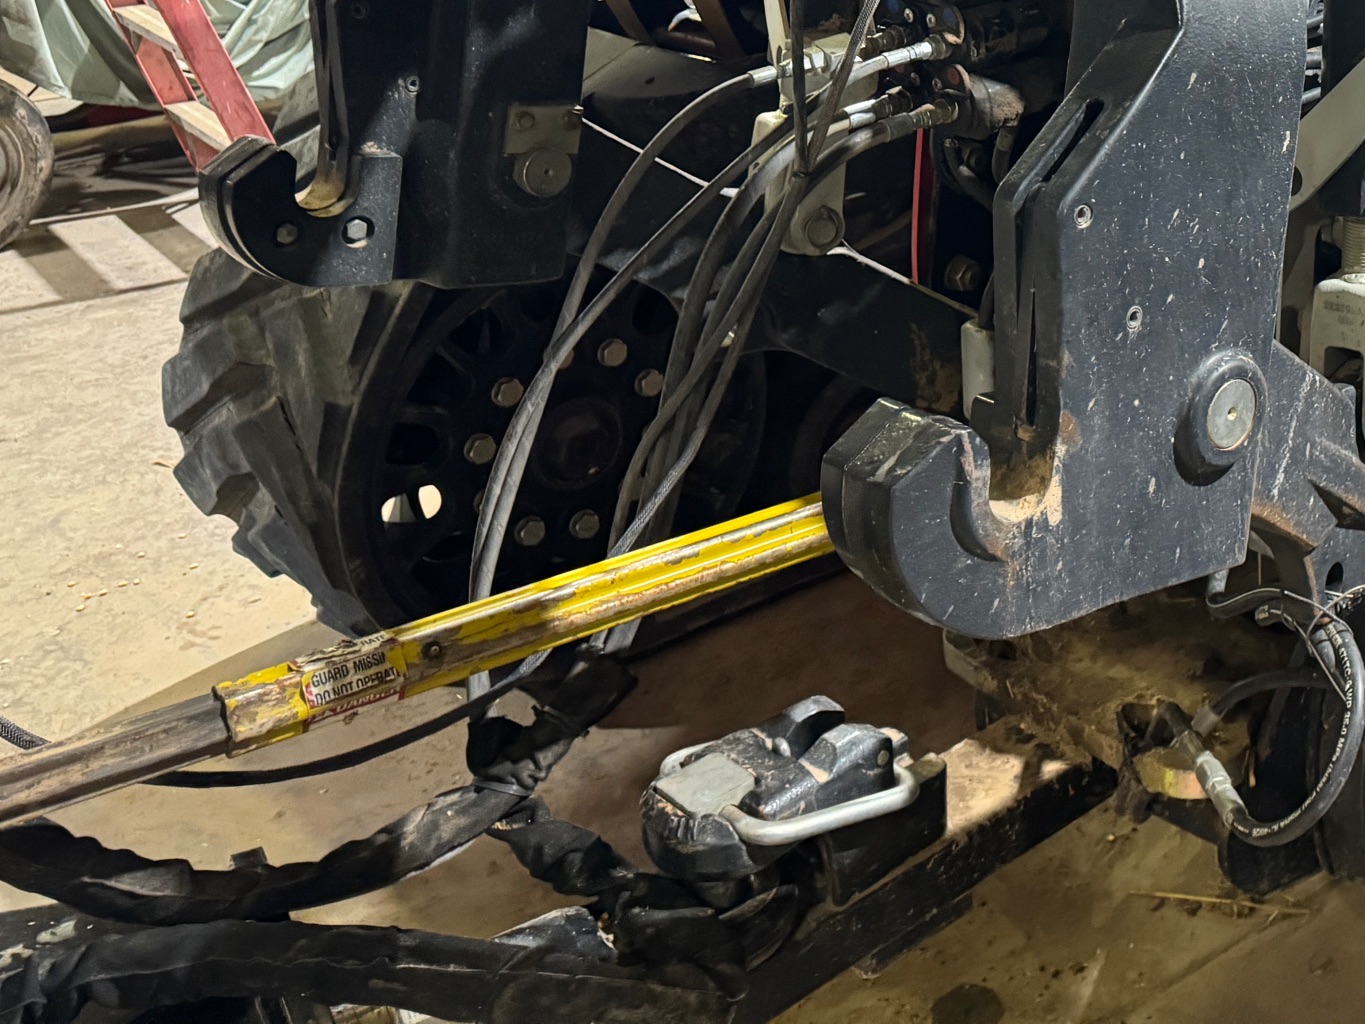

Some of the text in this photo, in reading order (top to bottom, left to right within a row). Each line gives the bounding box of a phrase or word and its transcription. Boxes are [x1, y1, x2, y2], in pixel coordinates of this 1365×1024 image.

[311, 664, 350, 688] GUARD
[314, 690, 331, 706] DO
[332, 681, 354, 697] NOT
